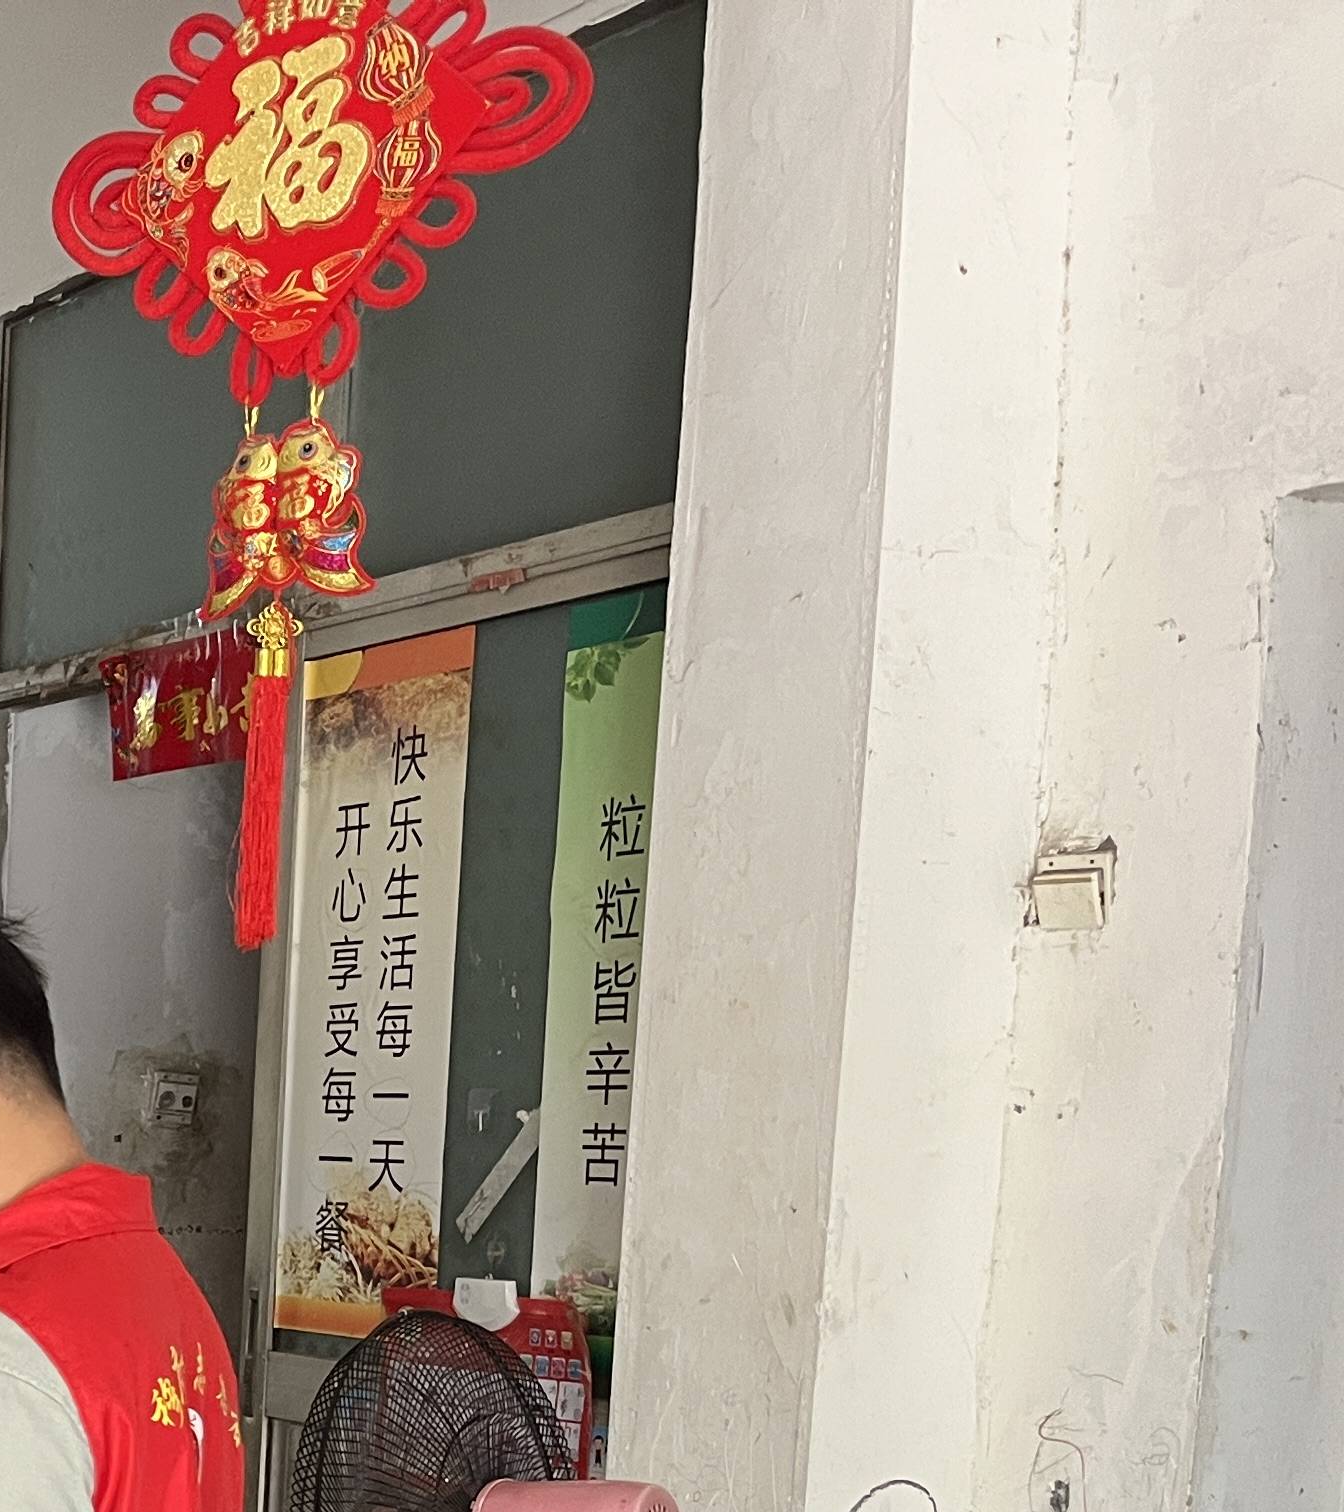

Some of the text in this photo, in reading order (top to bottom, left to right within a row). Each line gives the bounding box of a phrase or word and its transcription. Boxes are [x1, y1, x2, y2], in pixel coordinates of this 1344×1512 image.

[205, 35, 370, 238] 福
[315, 801, 372, 1252] 开心享受每一餐
[368, 725, 428, 1193] 快乐生活每一天
[582, 795, 647, 1188] 粒粒皆辛苦
